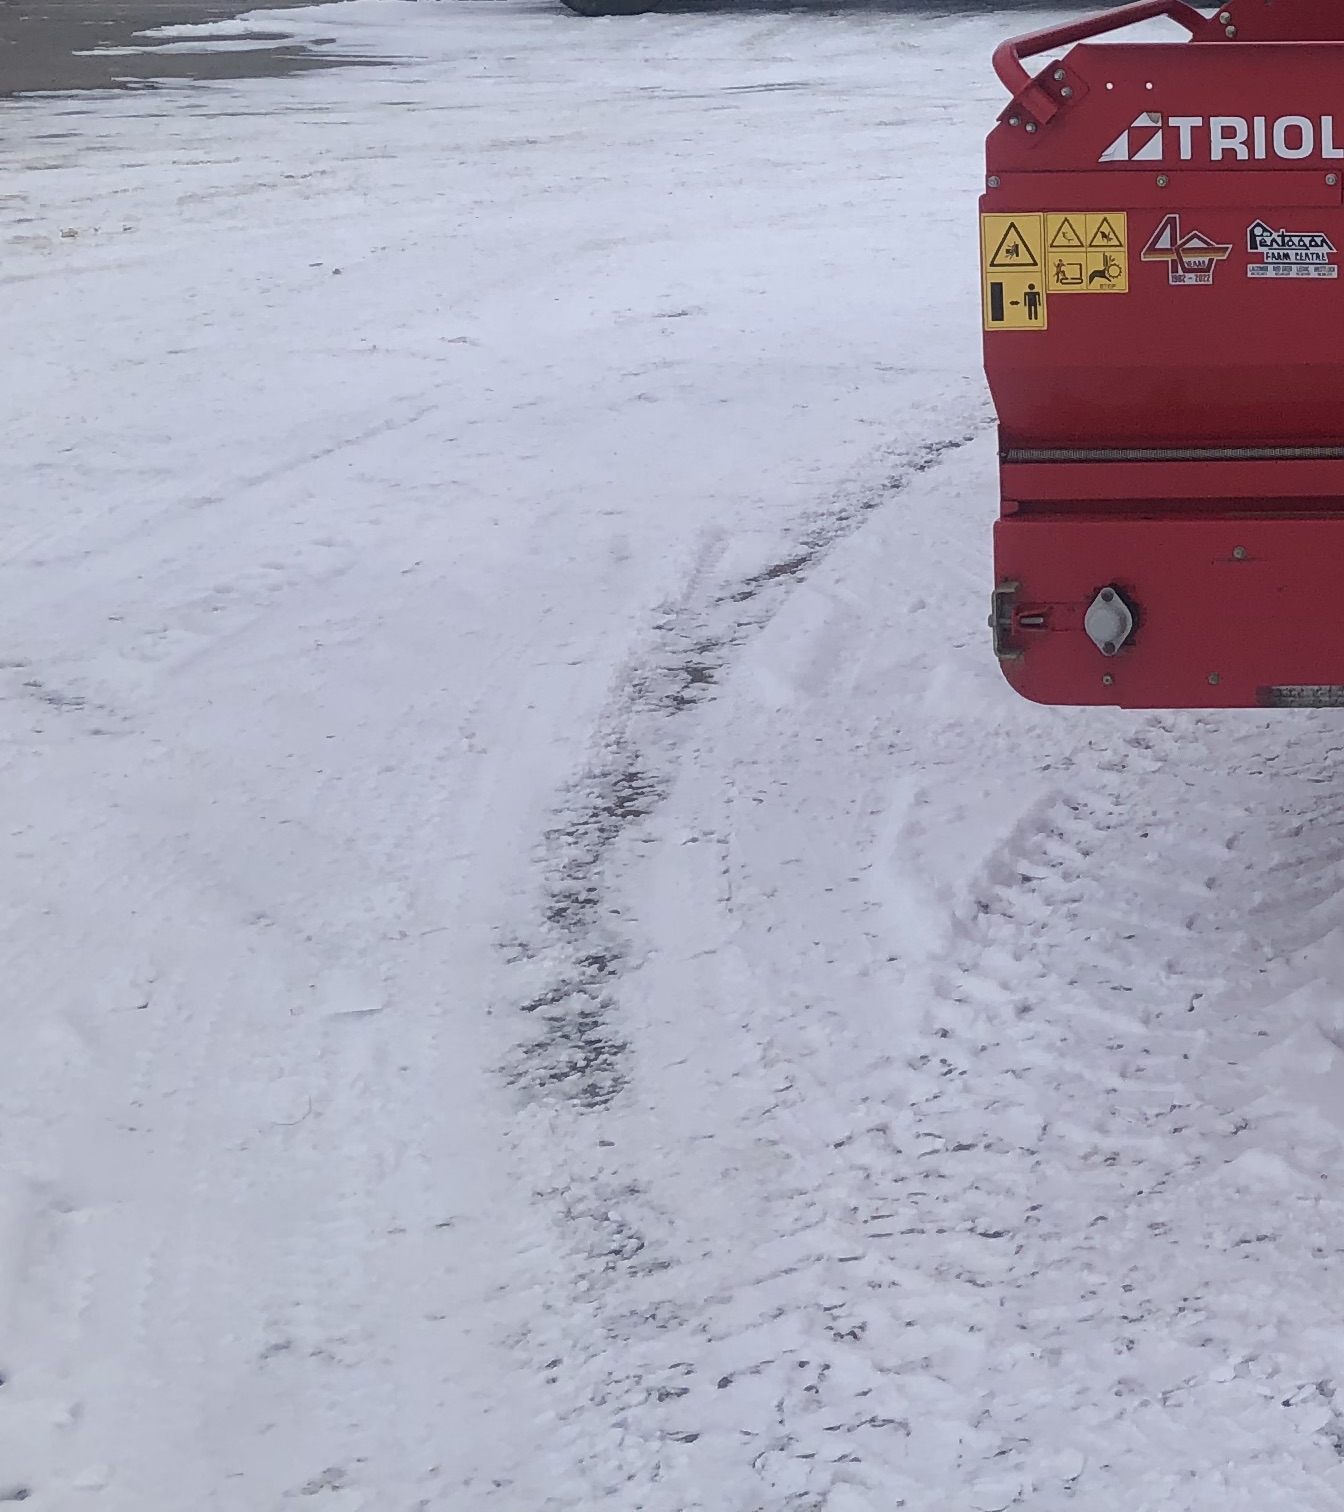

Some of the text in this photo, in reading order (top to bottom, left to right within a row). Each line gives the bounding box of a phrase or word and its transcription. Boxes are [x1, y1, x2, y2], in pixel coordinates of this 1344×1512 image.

[1249, 221, 1334, 250] Pentagon
[1265, 252, 1327, 262] FARM CENTRE
